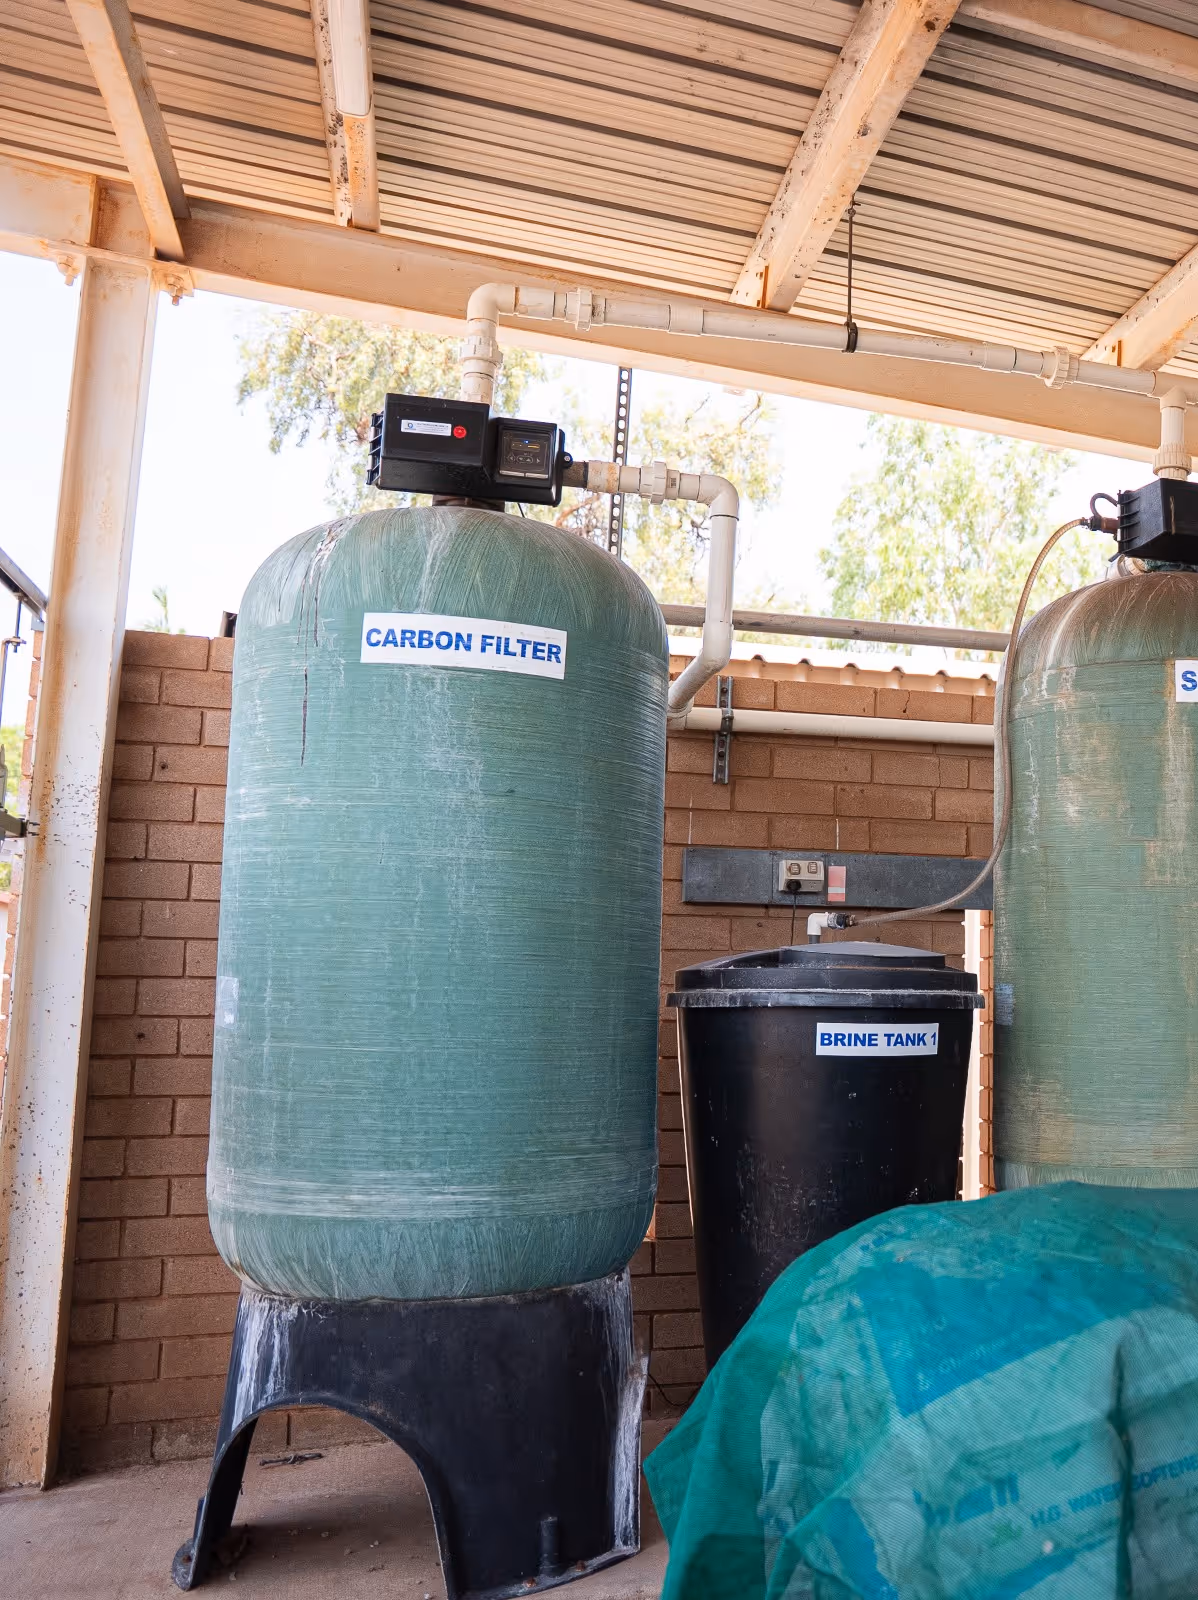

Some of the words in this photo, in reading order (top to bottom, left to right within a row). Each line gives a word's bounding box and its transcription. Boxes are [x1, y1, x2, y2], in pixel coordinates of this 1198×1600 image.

[365, 628, 473, 652] CARBON
[480, 634, 562, 664] FILTER
[820, 1032, 879, 1047] BRINE
[884, 1032, 928, 1047] TANK
[930, 1031, 937, 1046] 1
